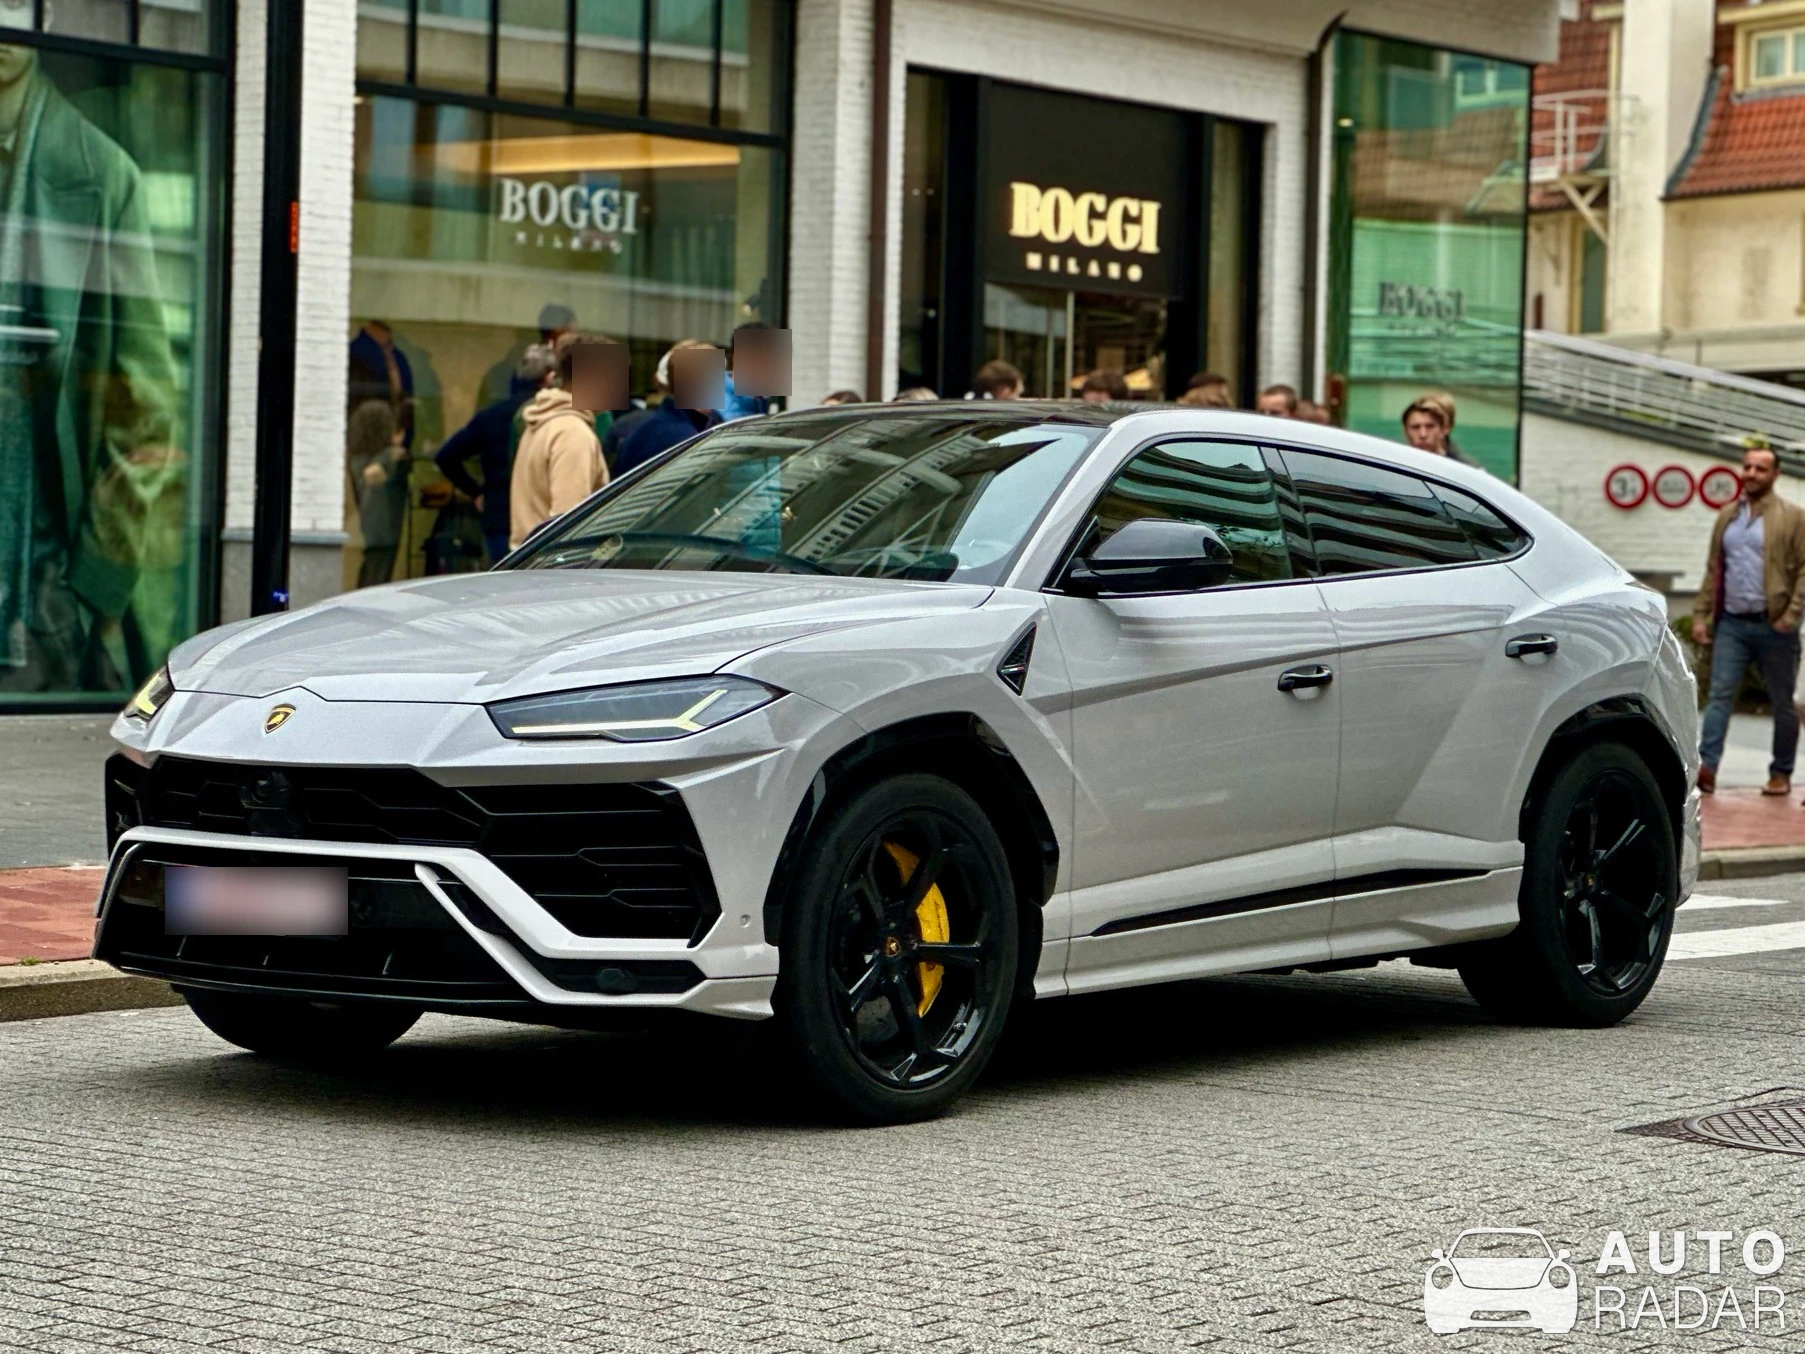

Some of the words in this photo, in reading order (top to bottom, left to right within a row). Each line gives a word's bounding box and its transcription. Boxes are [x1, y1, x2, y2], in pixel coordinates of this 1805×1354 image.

[500, 178, 639, 235] BOGGI
[1009, 182, 1161, 254] BOGGI
[1026, 252, 1143, 282] MILANO
